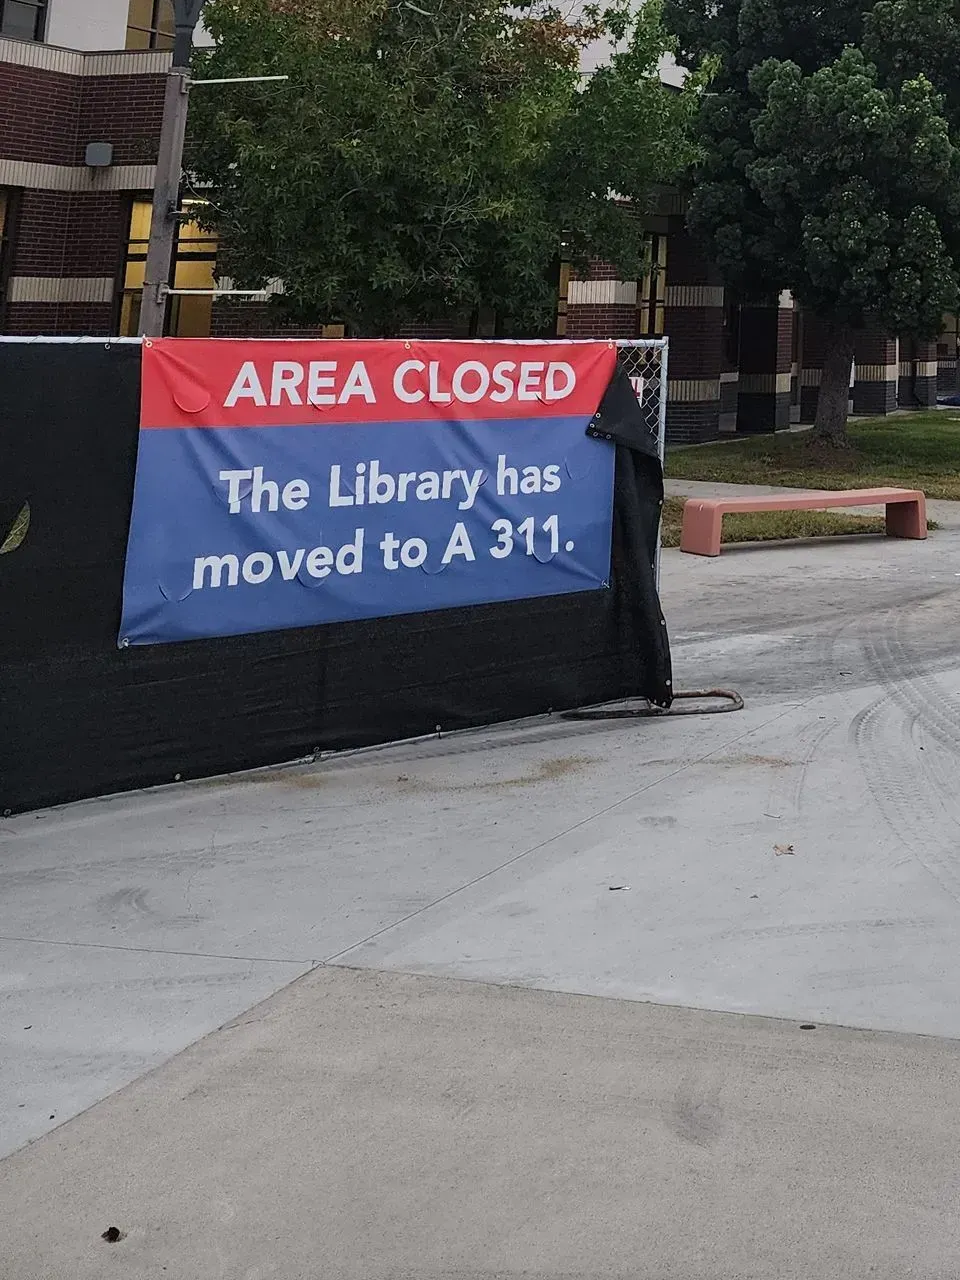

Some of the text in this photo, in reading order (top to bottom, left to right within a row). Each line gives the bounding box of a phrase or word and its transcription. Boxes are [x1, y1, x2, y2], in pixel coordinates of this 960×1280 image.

[223, 360, 376, 408] AREA
[393, 360, 577, 404] CLOSED
[219, 454, 561, 514] The Library has
[192, 514, 575, 589] moved to A 311.
